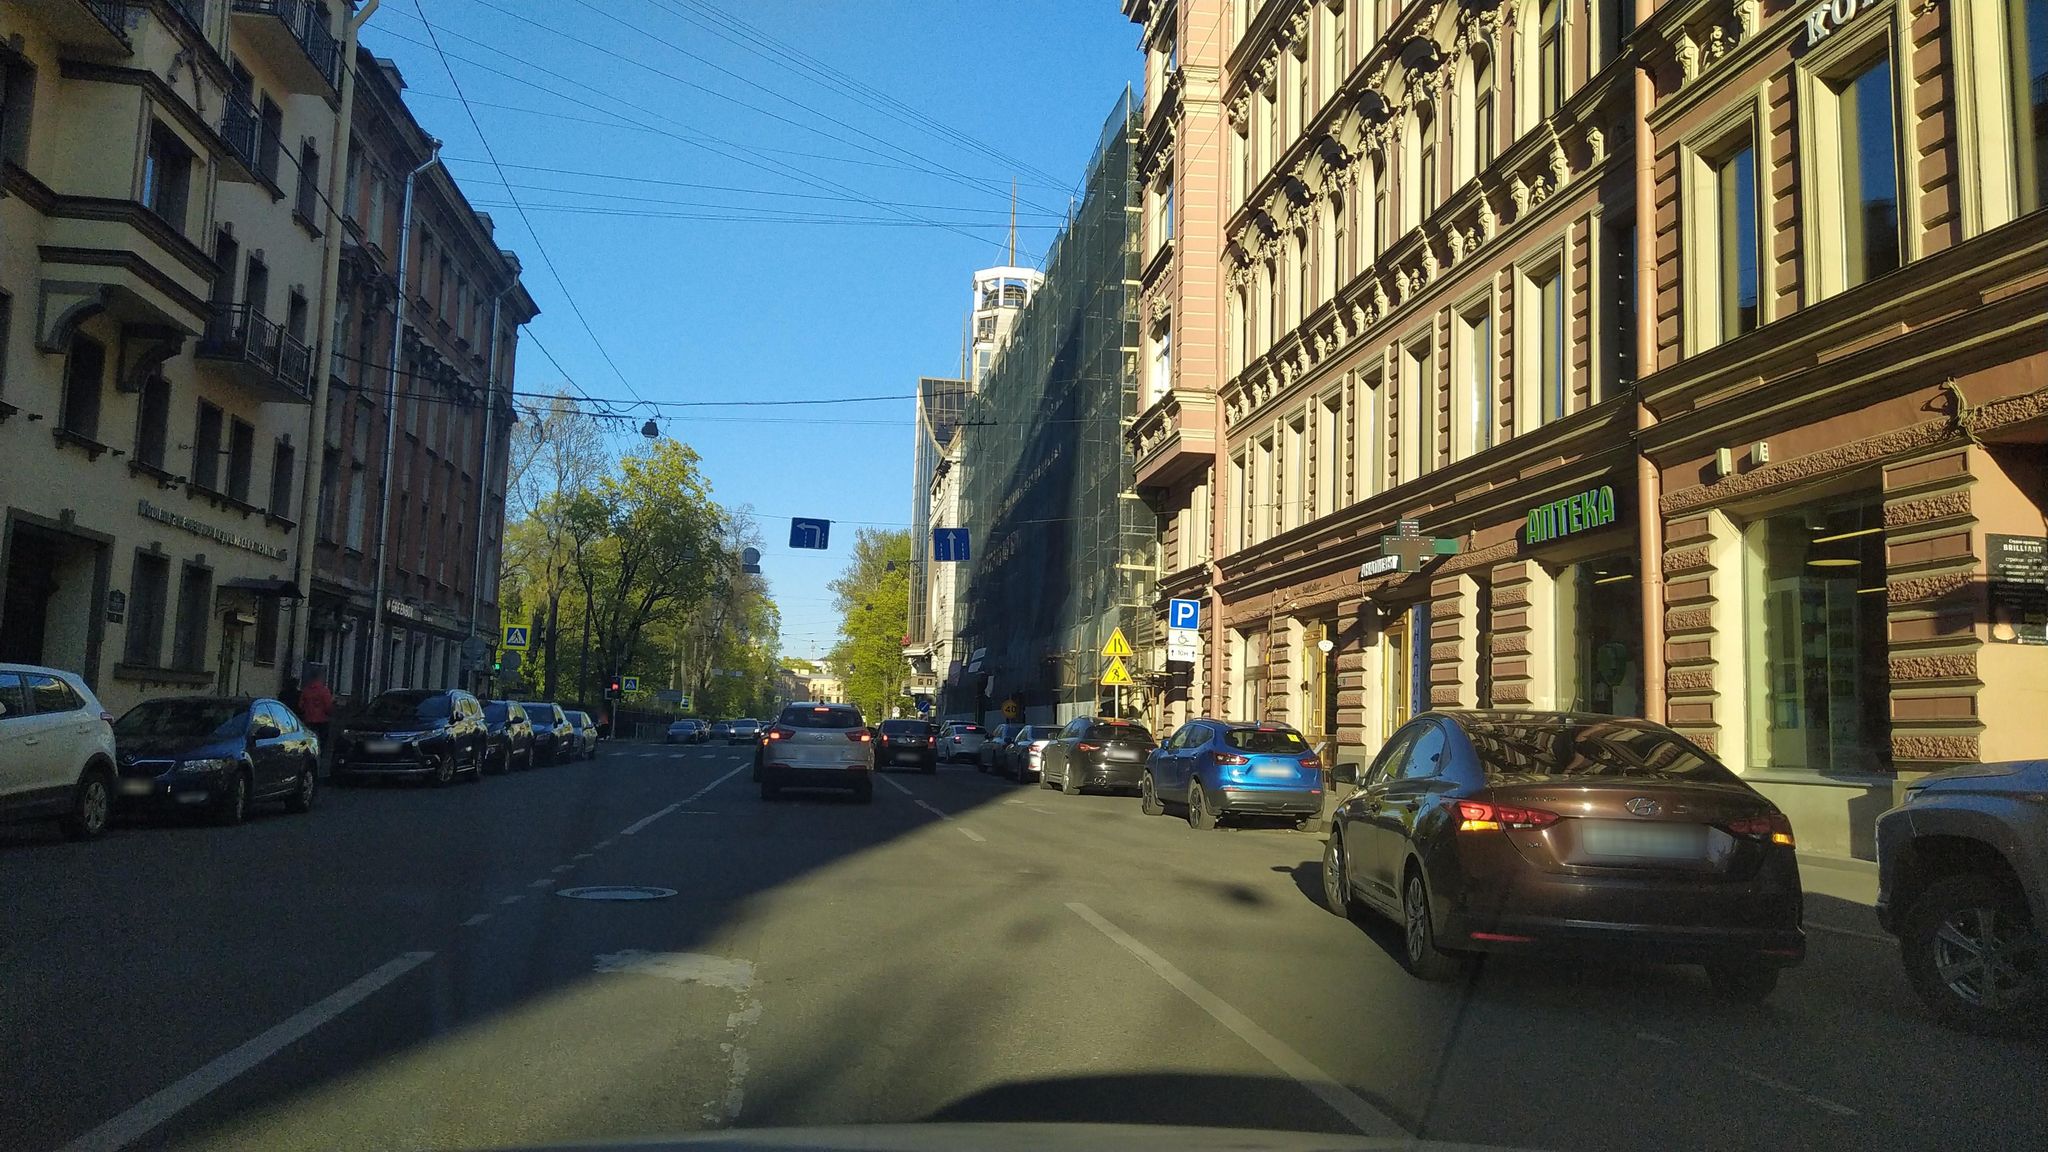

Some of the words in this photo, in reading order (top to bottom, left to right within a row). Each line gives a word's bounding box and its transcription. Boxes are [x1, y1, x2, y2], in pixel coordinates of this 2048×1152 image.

[1806, 0, 1875, 47] КО
[1526, 485, 1615, 545] АПТЕКА
[2003, 544, 2043, 553] BRILLIANT
[1177, 602, 1195, 626] P
[1412, 609, 1421, 714] АНАЛИЗ
[1004, 704, 1017, 713] 40
